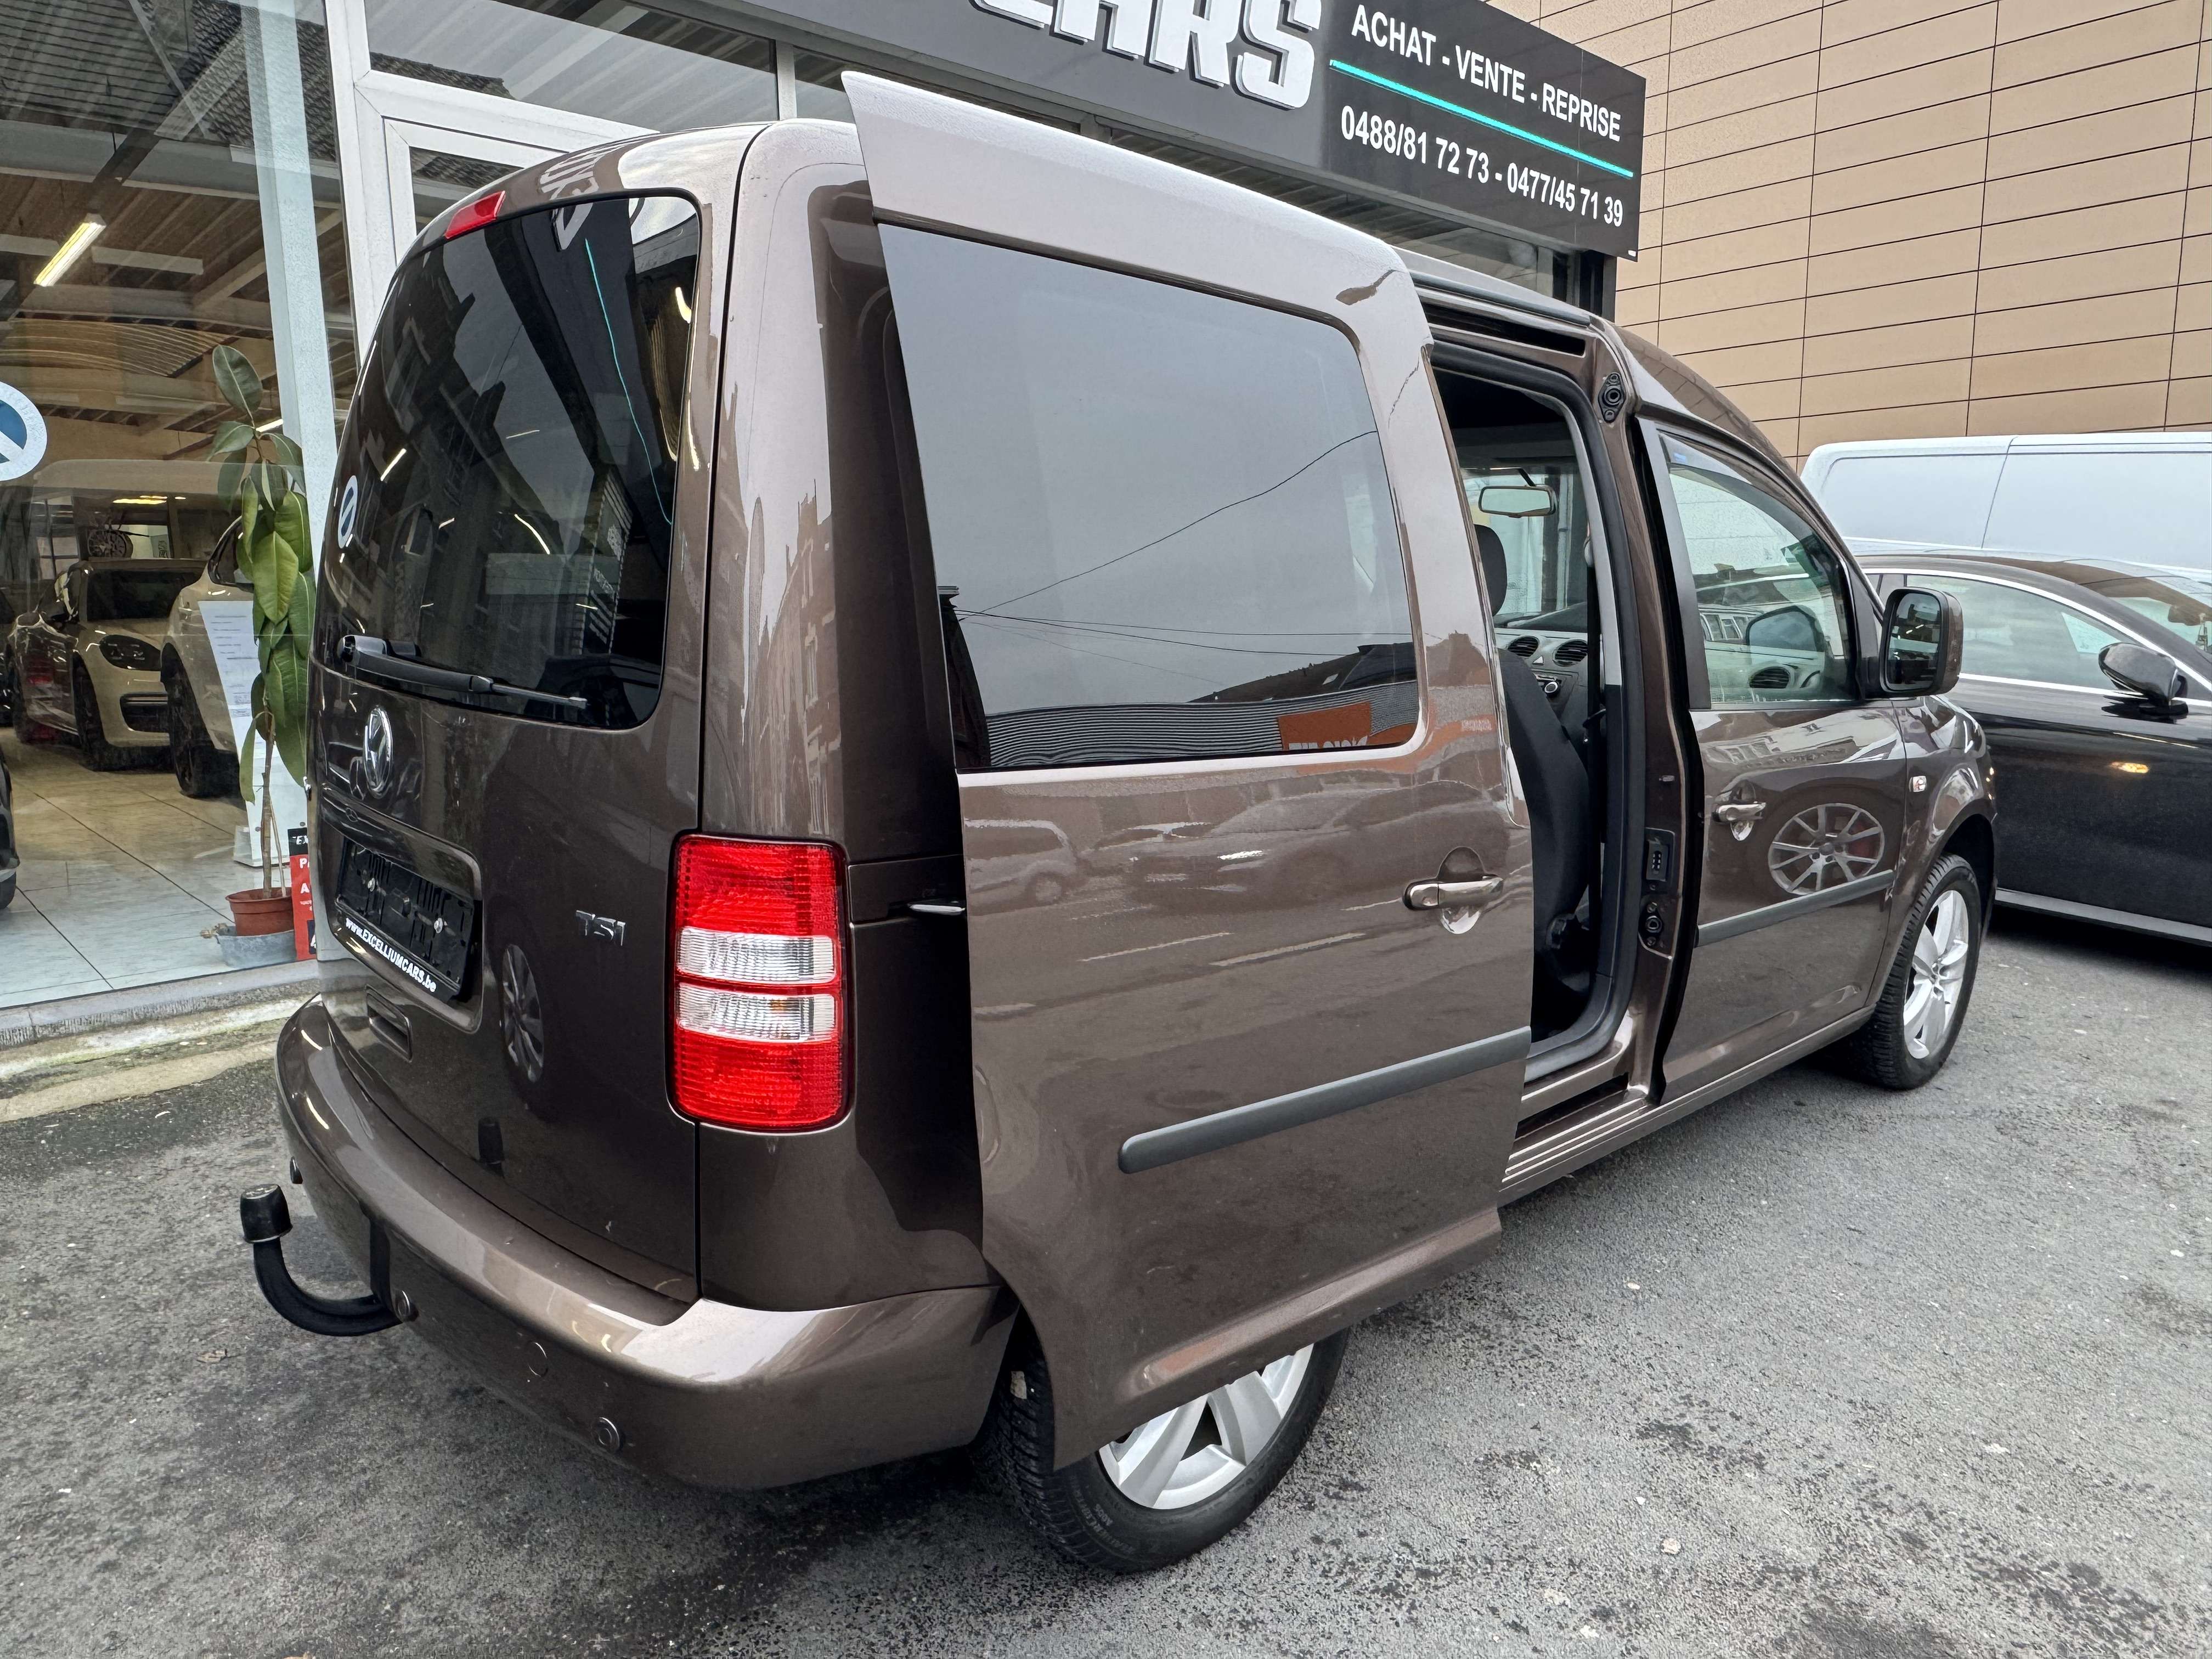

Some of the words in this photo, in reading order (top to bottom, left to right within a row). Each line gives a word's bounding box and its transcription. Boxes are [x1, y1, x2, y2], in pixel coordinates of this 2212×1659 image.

[972, 0, 1321, 110] RS
[1351, 4, 1437, 66] ACHAT
[1455, 44, 1526, 103] VENTE
[1542, 82, 1622, 142] REPRISE
[1341, 105, 1426, 163] 0488/81
[1436, 137, 1460, 174] 72
[1466, 147, 1489, 183] 73
[1507, 162, 1576, 212] 0477/45
[1581, 187, 1599, 219] 71
[1604, 196, 1623, 227] 39
